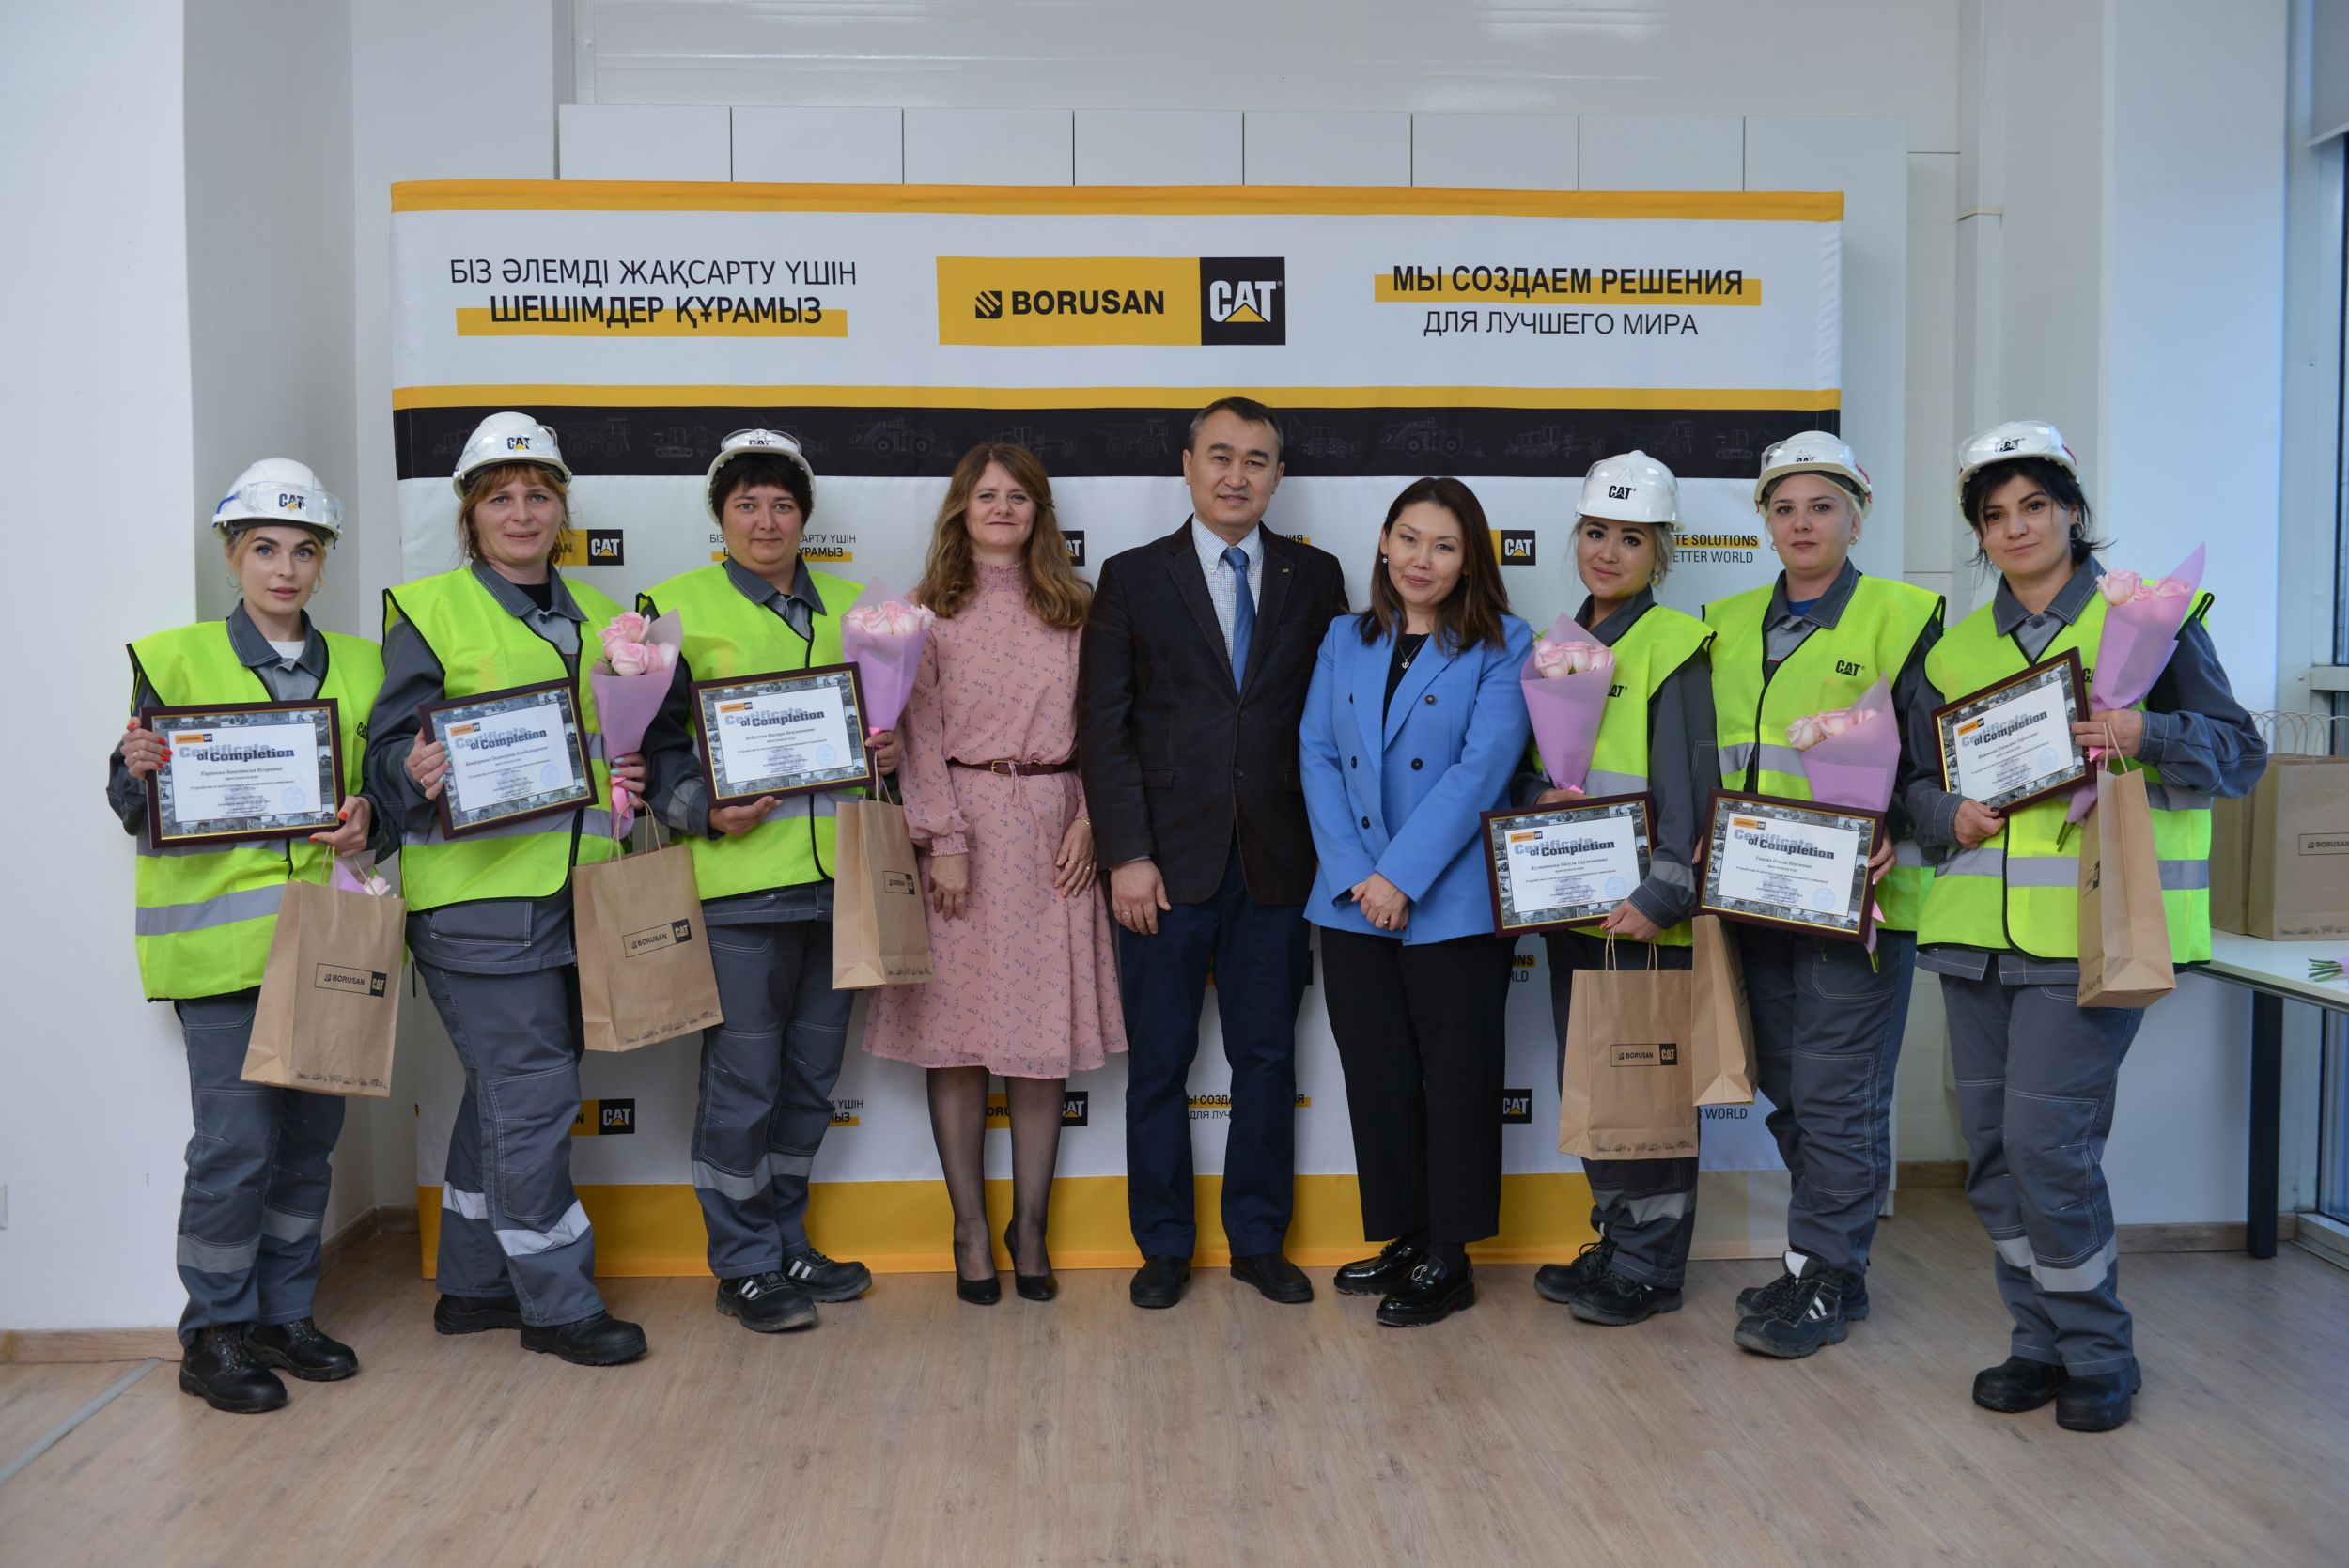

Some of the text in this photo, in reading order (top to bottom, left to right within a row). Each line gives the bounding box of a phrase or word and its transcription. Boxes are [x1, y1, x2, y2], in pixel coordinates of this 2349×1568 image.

[450, 258, 856, 288] БІЗ ӘЛЕМДІ ЖАҚСАРТУ ҮШІН
[1392, 266, 1743, 298] МЫ СОЗДАЕМ РЕШЕНИЯ
[1012, 280, 1277, 323] BORUSAN CAT
[490, 295, 822, 329] ШЕШІМДЕР ҚҰРАМЫЗ
[1423, 311, 1699, 337] ДЛЯ ЛУЧШЕГО МИРА
[507, 437, 530, 450] CAT
[279, 493, 304, 510] CAT
[1609, 486, 1632, 500] CAT
[591, 538, 620, 556] CAT
[831, 534, 856, 544] ҮШІН
[1504, 538, 1532, 556] CAT
[1691, 534, 1758, 547] SOLUTIONS
[799, 548, 843, 558] ҰРАМЫЗ
[1672, 551, 1753, 563] ETTER WORLD
[1835, 660, 1860, 676] CAT
[740, 710, 825, 727] of Completion
[1974, 735, 1983, 746] of
[1983, 711, 2048, 743] Completion
[470, 729, 548, 751] of Completion
[196, 748, 295, 762] of Completion
[1530, 841, 1615, 856] of Completion
[1749, 836, 1759, 846] of
[1759, 839, 1835, 860] Completion
[638, 924, 689, 947] BORUSAN CAT
[333, 974, 365, 986] BORUSAN
[1661, 1049, 1675, 1060] CAT
[1503, 1098, 1529, 1114] CAT
[1704, 1108, 1748, 1120] WORLD
[602, 1108, 631, 1126] CAT
